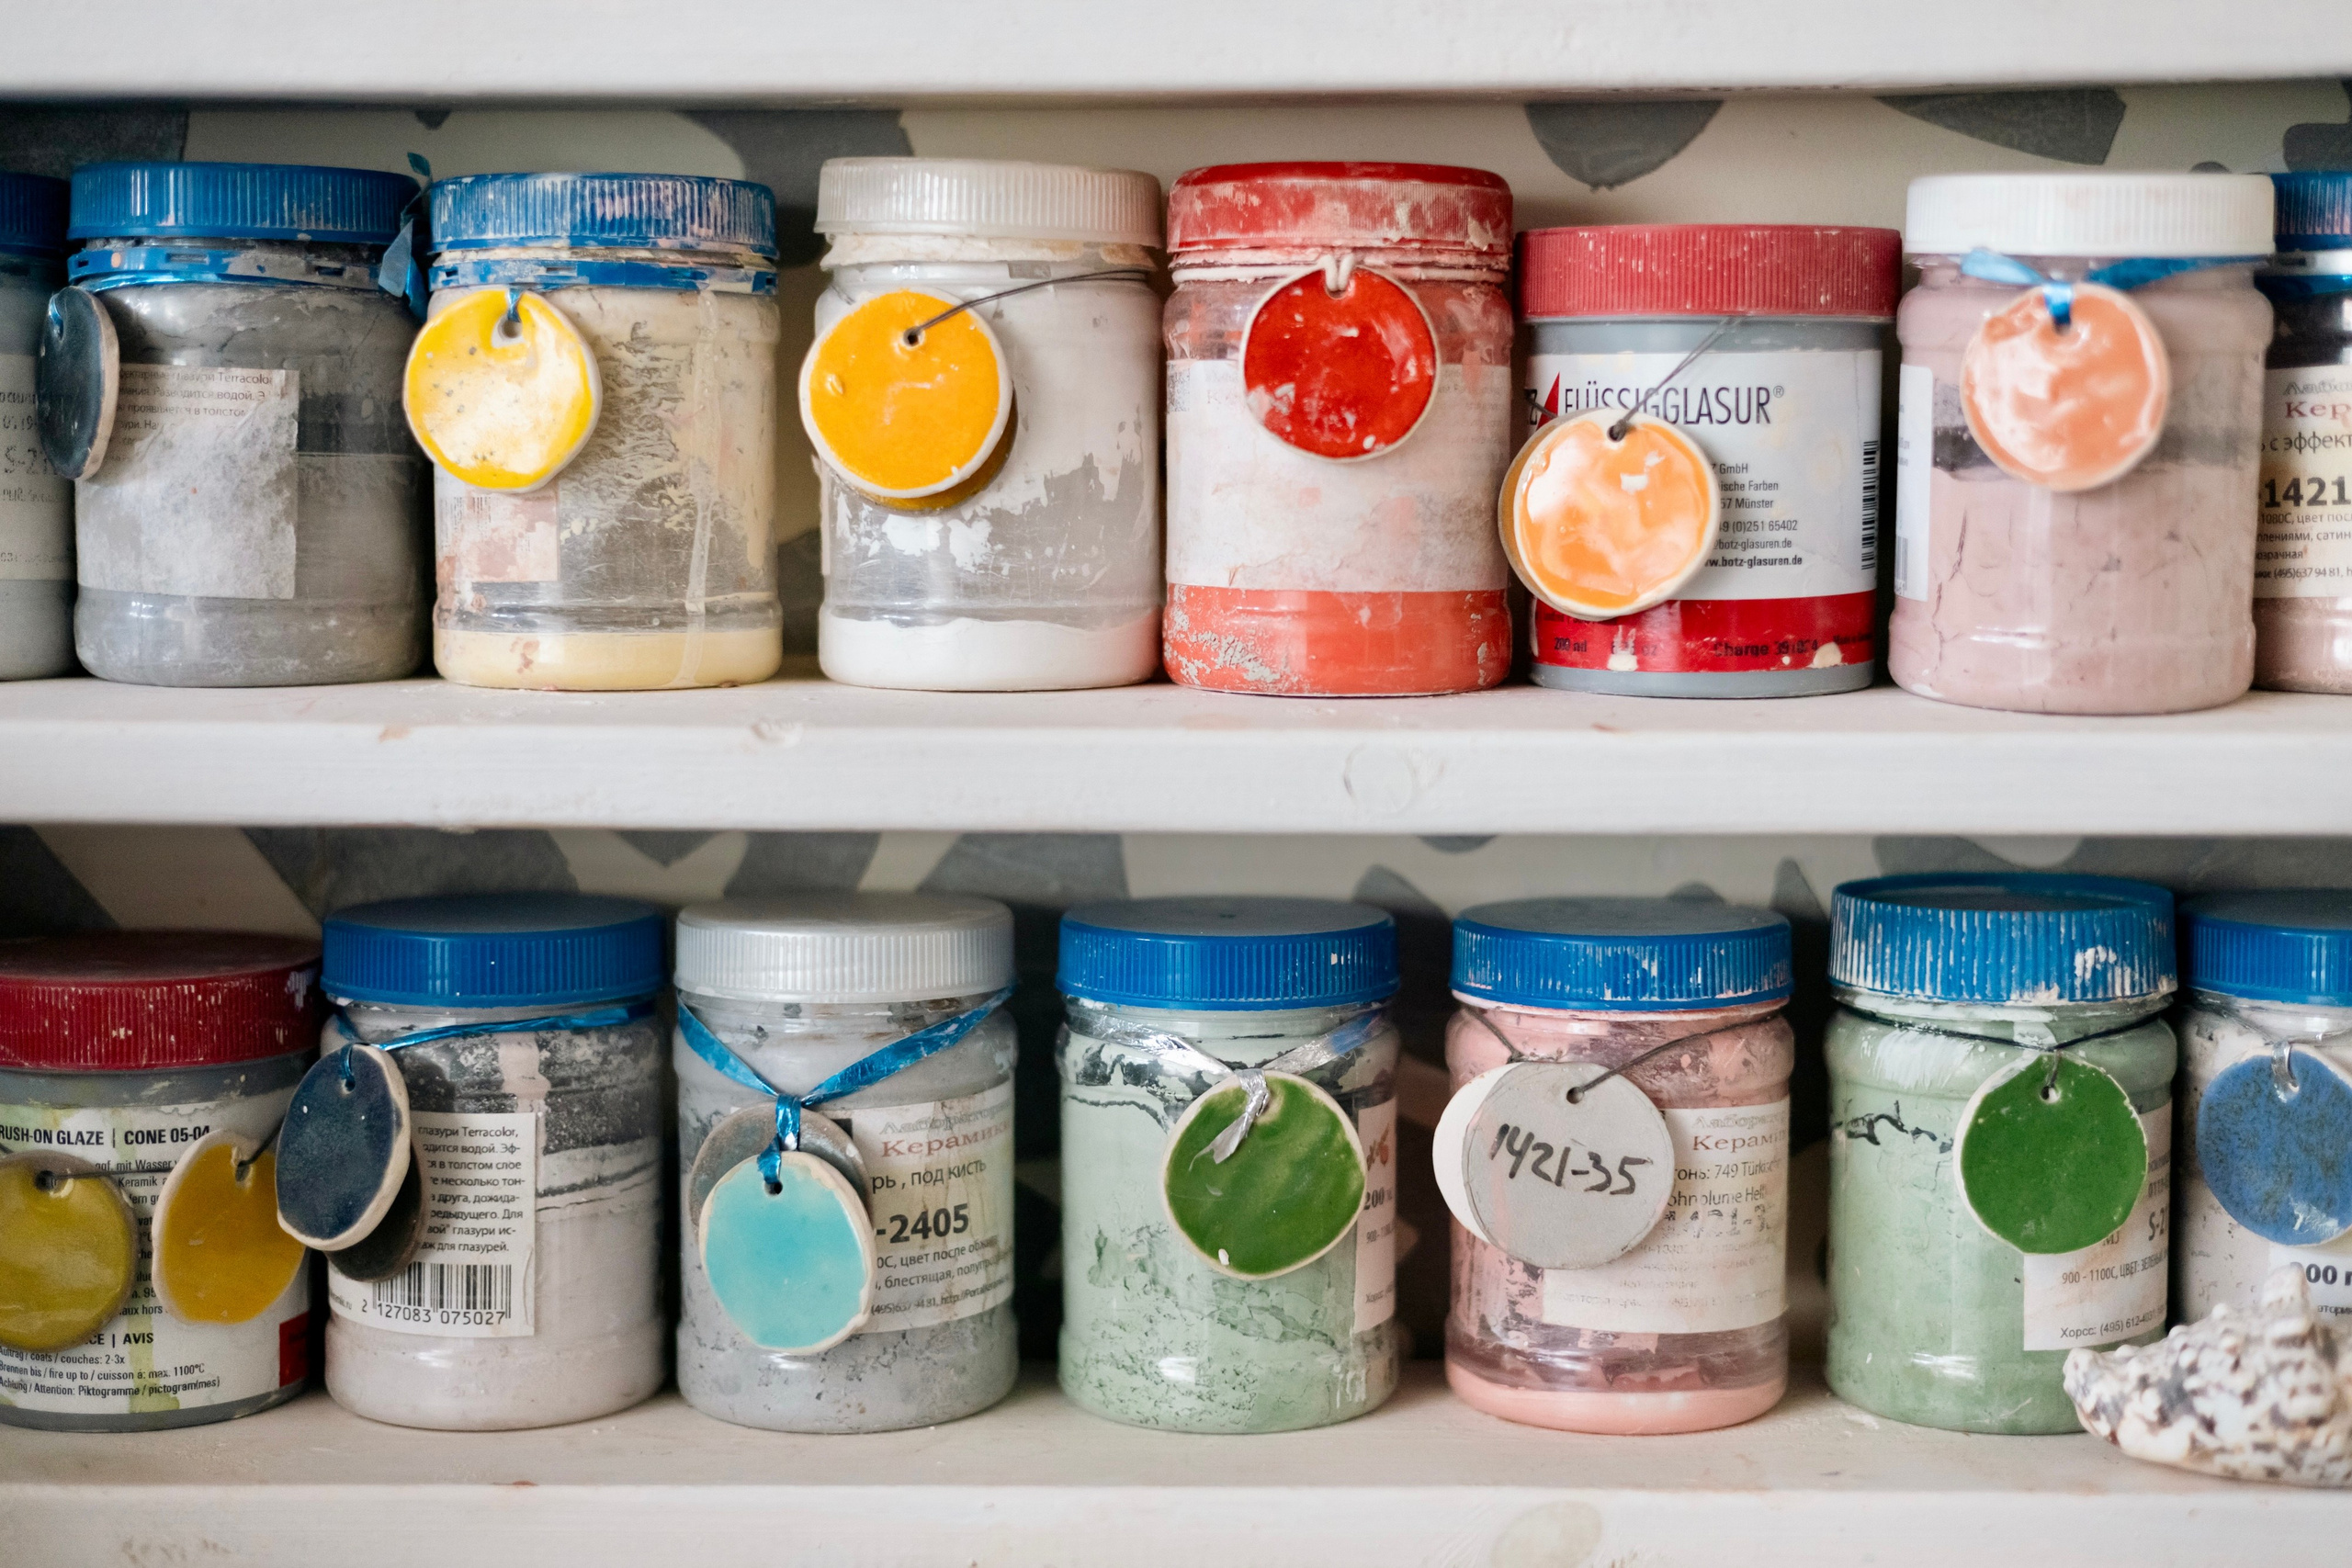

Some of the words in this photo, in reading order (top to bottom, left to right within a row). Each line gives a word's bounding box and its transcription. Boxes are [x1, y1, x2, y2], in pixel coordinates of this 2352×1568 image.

[1719, 462, 1749, 475] GmbH
[1718, 479, 1746, 492] ische
[1748, 479, 1779, 491] Farben
[1735, 497, 1774, 510] Münster
[1768, 519, 1799, 532] 65402
[2297, 513, 2324, 525] цвет
[56, 1129, 105, 1146] GLAZE
[123, 1129, 166, 1146] CONE
[418, 1126, 458, 1139] глазури
[461, 1126, 519, 1138] Terracolor,
[460, 1143, 498, 1156] водой.
[116, 1159, 132, 1172] mit
[135, 1158, 173, 1171] Wasser
[448, 1160, 493, 1170] толстом
[495, 1160, 522, 1170] слое
[1489, 1122, 1654, 1195] 1421-35
[910, 1168, 944, 1187] под
[947, 1158, 987, 1180] кисть
[1714, 1163, 1738, 1179] 749
[118, 1175, 158, 1188] Keramik
[441, 1177, 500, 1187] несколько
[502, 1177, 526, 1186] тон-
[437, 1193, 471, 1204] друга,
[502, 1208, 524, 1220] Для
[876, 1202, 970, 1245] -2405
[452, 1226, 495, 1238] глазури
[436, 1243, 456, 1252] для
[458, 1241, 510, 1255] глазурей.
[899, 1252, 931, 1268] цвет
[933, 1246, 967, 1263] после
[884, 1269, 956, 1290] блестящая,
[2062, 1271, 2080, 1285] 900
[2290, 1261, 2338, 1285] 00
[119, 1305, 140, 1316] aux
[141, 1303, 164, 1315] hors
[362, 1298, 368, 1313] 2
[378, 1303, 432, 1324] 127083
[440, 1309, 506, 1325] 075027
[122, 1332, 154, 1345] AVIS
[60, 1353, 103, 1365] couches:
[105, 1353, 126, 1365] 2-3x
[29, 1365, 42, 1378] bis
[49, 1367, 64, 1380] fire
[66, 1371, 77, 1382] up
[80, 1370, 89, 1381] to
[97, 1369, 134, 1381] cuisson
[148, 1370, 171, 1380] max.
[34, 1382, 75, 1396] Attention:
[78, 1384, 141, 1399] Piktogramme
[148, 1375, 221, 1397] pictogram(mes)
